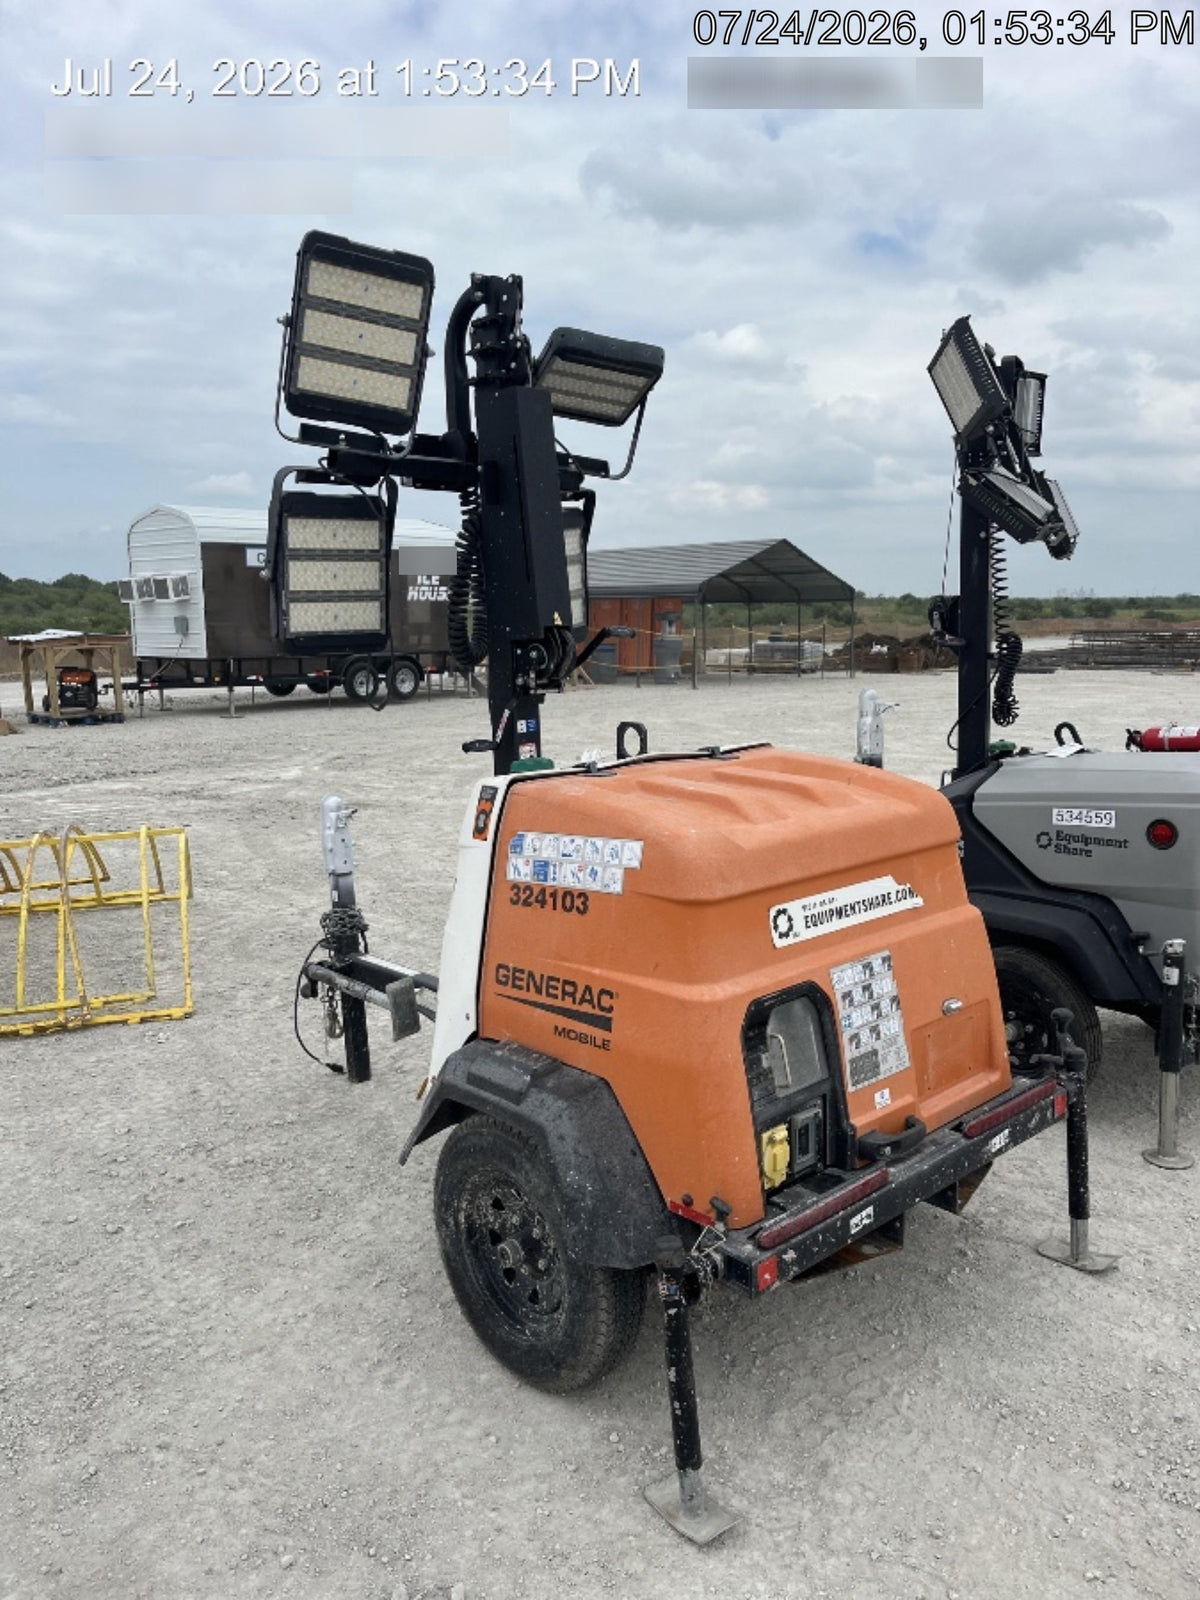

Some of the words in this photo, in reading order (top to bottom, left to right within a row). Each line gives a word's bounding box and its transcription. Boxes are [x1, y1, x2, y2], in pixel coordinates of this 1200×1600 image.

[407, 586, 451, 601] HOUS
[1055, 809, 1114, 826] 534559
[1055, 829, 1129, 849] Equipment
[1054, 842, 1093, 858] Share
[509, 883, 590, 915] 324103
[495, 962, 615, 1014] GENERAC
[552, 1024, 612, 1052] MOBILE
